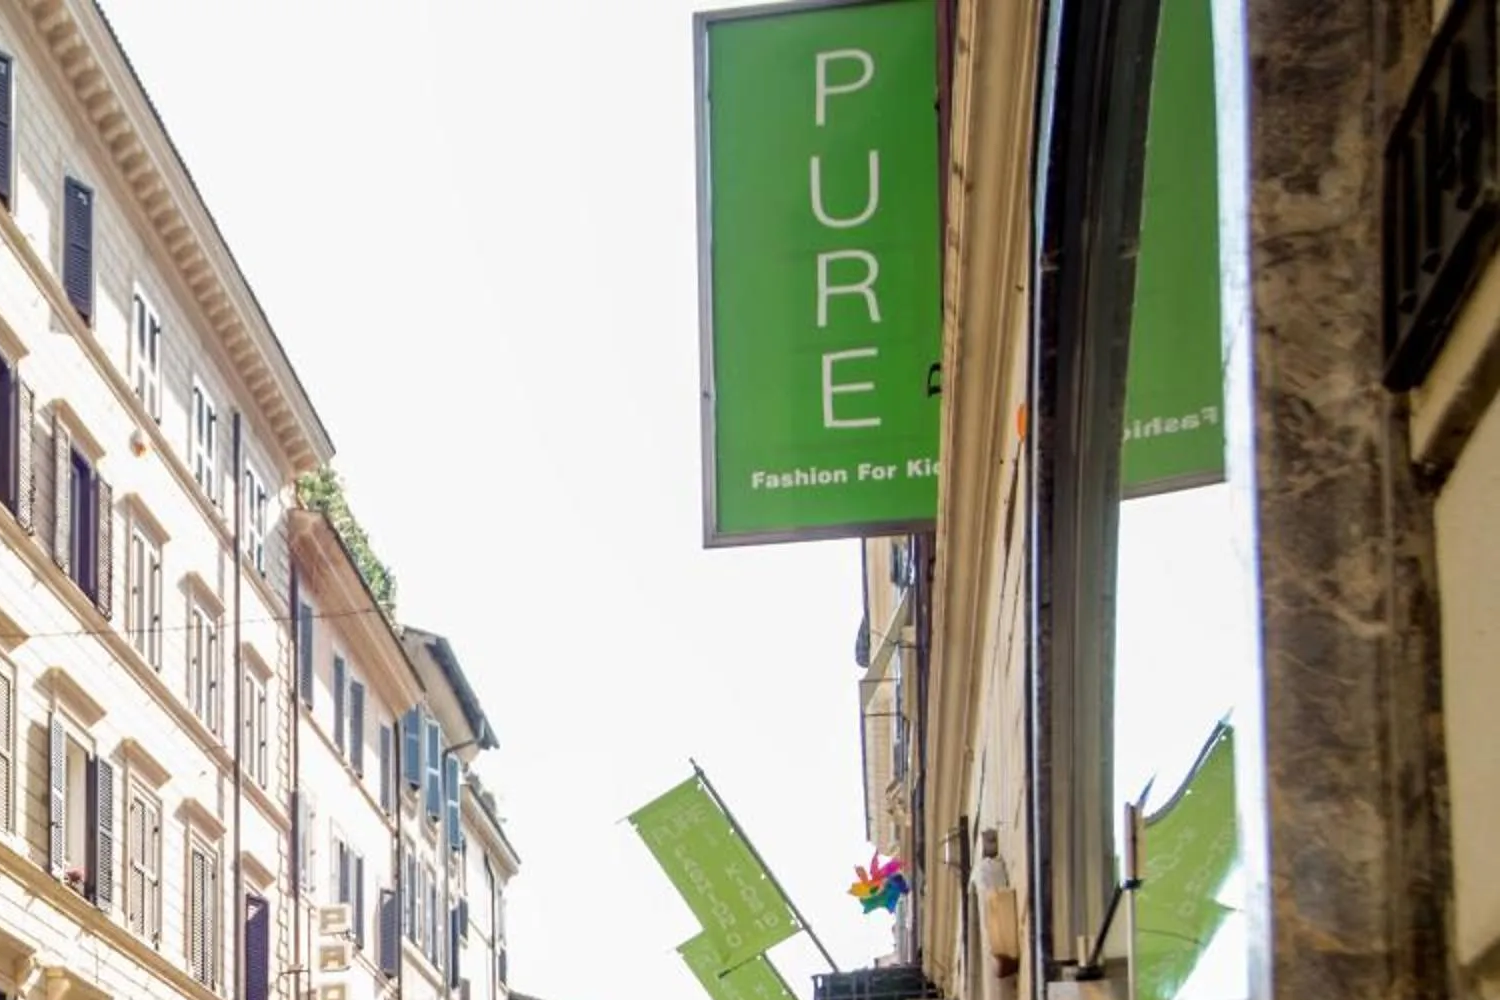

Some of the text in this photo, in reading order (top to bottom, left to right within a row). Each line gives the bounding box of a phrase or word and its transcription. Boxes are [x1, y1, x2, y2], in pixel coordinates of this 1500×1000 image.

[809, 48, 882, 430] PURE
[752, 466, 848, 490] Fashion
[857, 462, 898, 482] For
